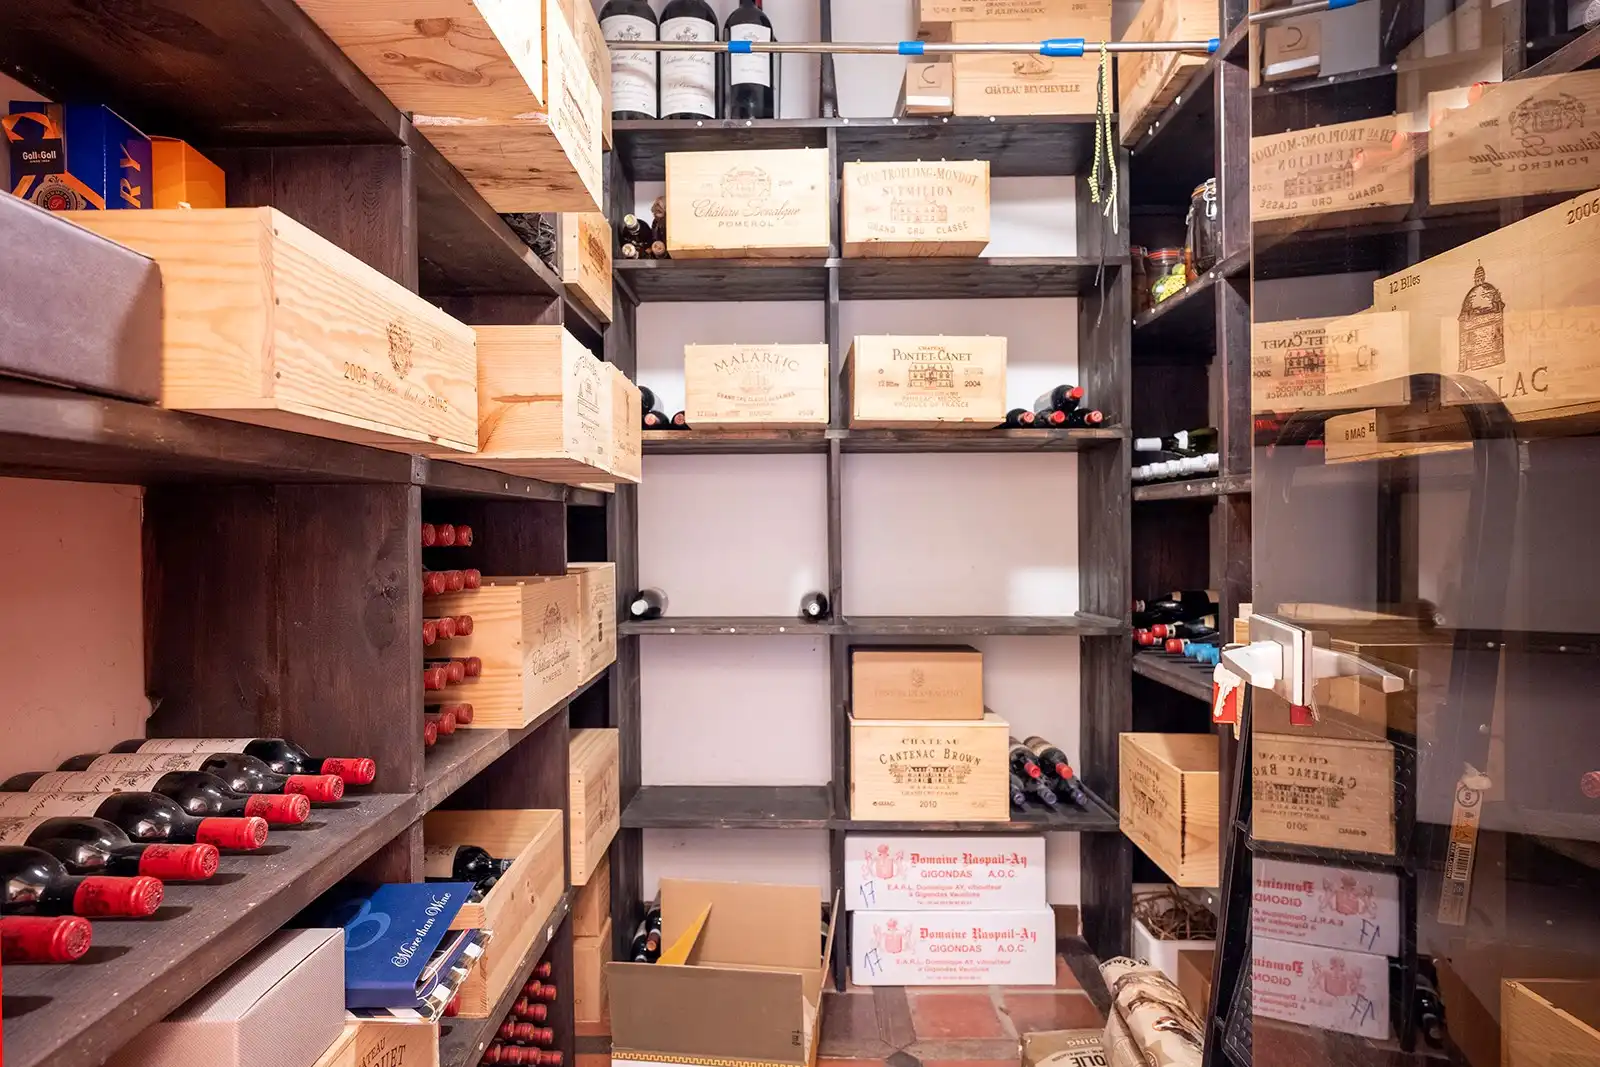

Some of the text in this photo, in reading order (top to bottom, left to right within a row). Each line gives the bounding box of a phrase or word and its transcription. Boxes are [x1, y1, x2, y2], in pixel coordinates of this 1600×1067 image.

[1023, 83, 1081, 94] BEYCHEVELLE
[1566, 198, 1600, 225] 2006
[718, 220, 775, 228] POMEROL
[1389, 280, 1399, 294] 12
[892, 348, 973, 362] PONTET-CANET
[713, 351, 800, 373] MALARTIC
[964, 380, 982, 388] 2004
[1350, 426, 1366, 440] MAG
[1368, 422, 1375, 433] H
[879, 748, 982, 766] CANTENAC BROWN
[919, 800, 938, 808] 2010
[910, 852, 958, 866] Domaine
[920, 869, 973, 879] GIGONDAS
[391, 892, 452, 968] More than Wine
[919, 927, 968, 940] Domaine
[929, 944, 982, 953] GIGONDAS
